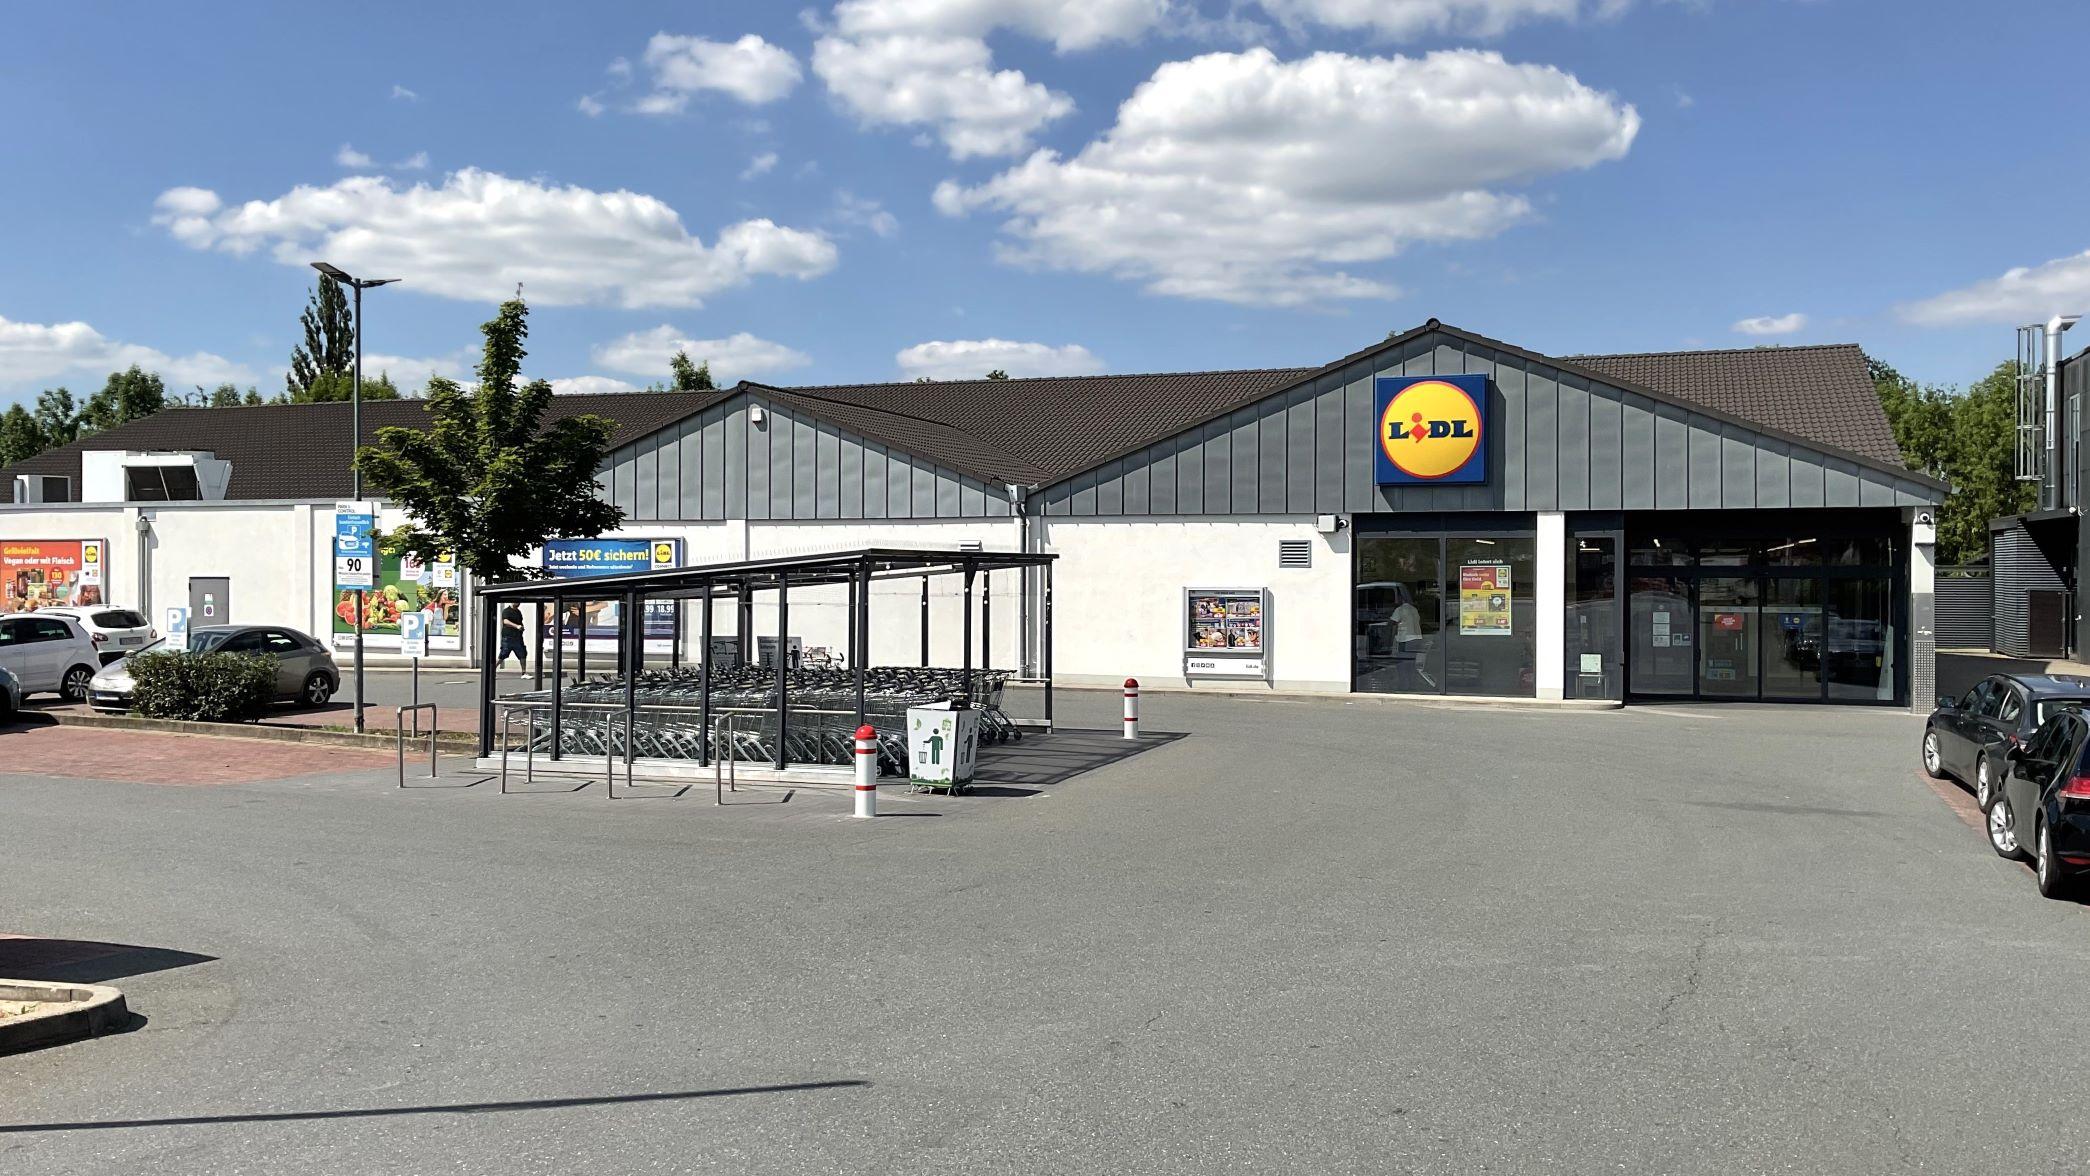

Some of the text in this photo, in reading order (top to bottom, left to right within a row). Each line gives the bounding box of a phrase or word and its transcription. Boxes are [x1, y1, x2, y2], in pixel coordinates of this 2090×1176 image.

[549, 549, 649, 561] Jetzt 50€ sichern!
[3, 557, 75, 566] Vegan oder mit Fleisch
[347, 558, 361, 571] 90
[403, 614, 420, 639] P
